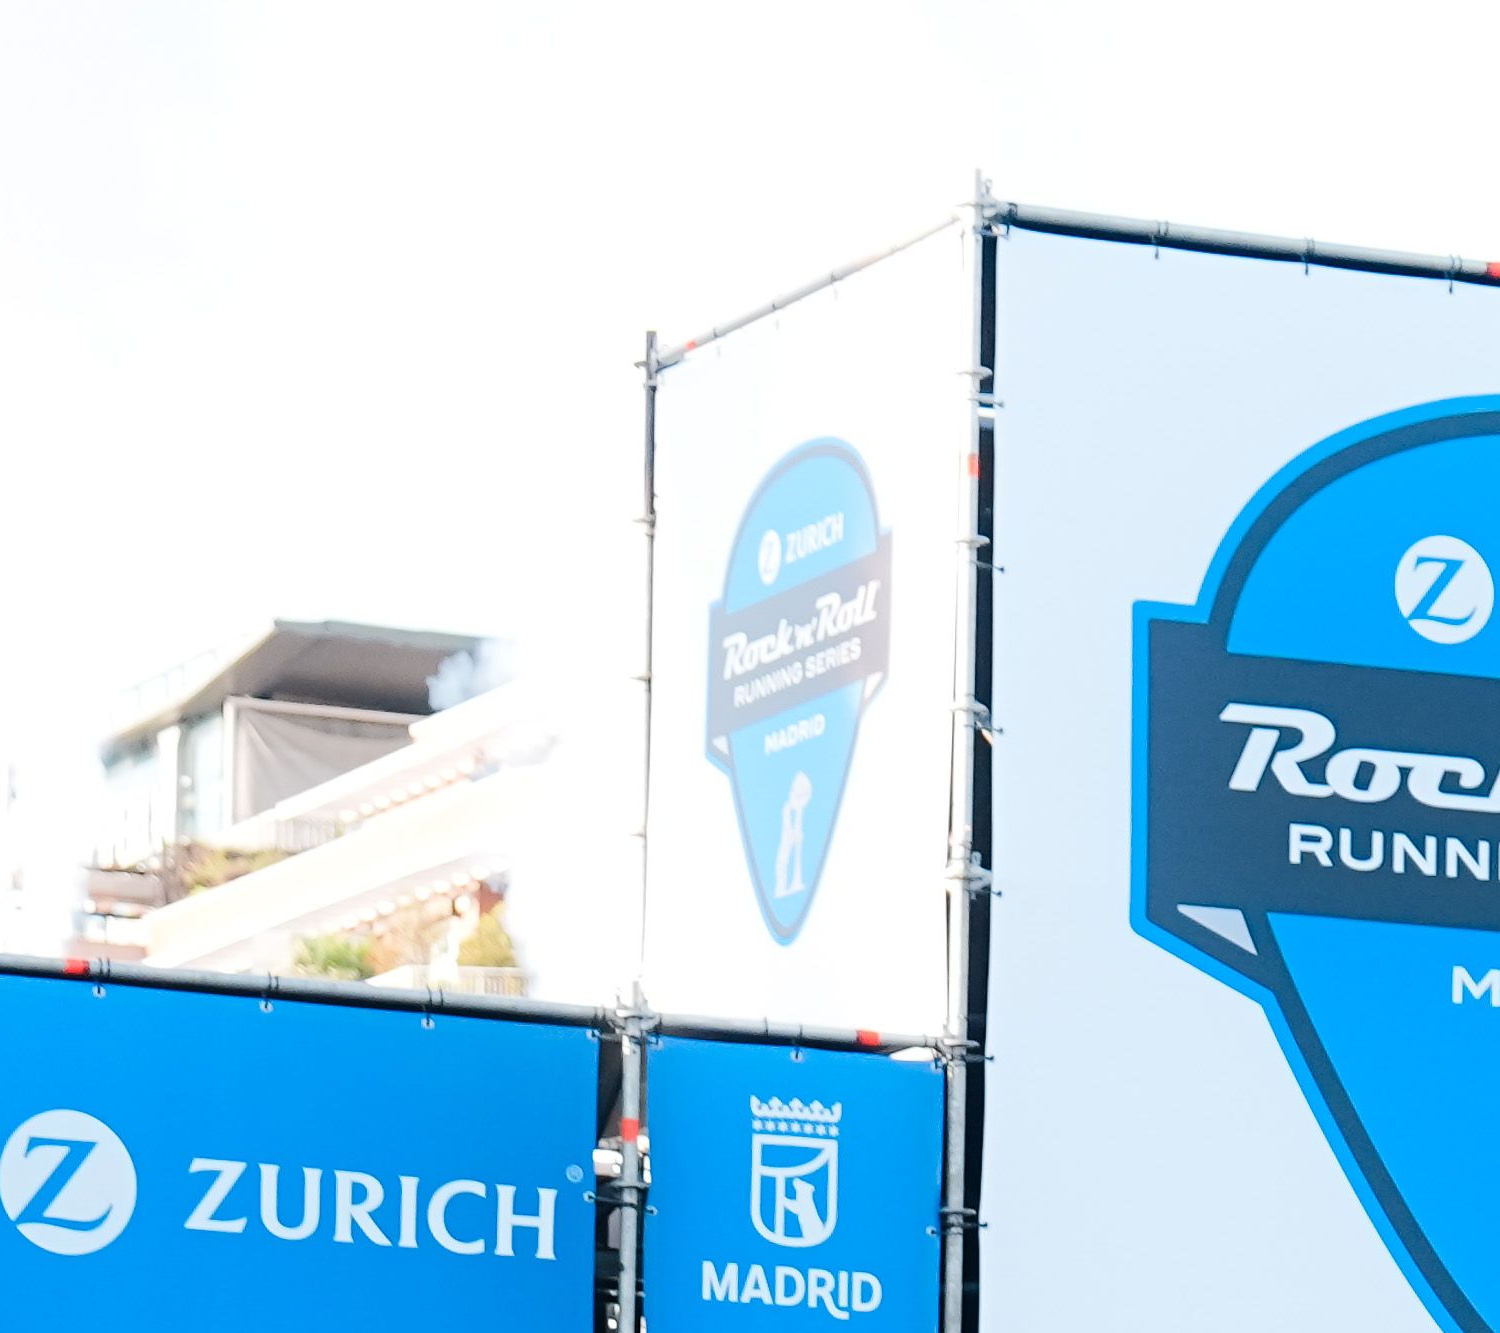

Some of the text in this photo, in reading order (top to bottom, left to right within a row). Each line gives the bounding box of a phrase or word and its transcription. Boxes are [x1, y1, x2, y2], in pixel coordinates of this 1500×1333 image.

[785, 511, 844, 564] ZURICH
[733, 636, 861, 708] RUNNING SERIES
[764, 713, 825, 755] MADRID
[184, 1156, 559, 1260] ZURICH
[701, 1260, 883, 1321] MADRID
